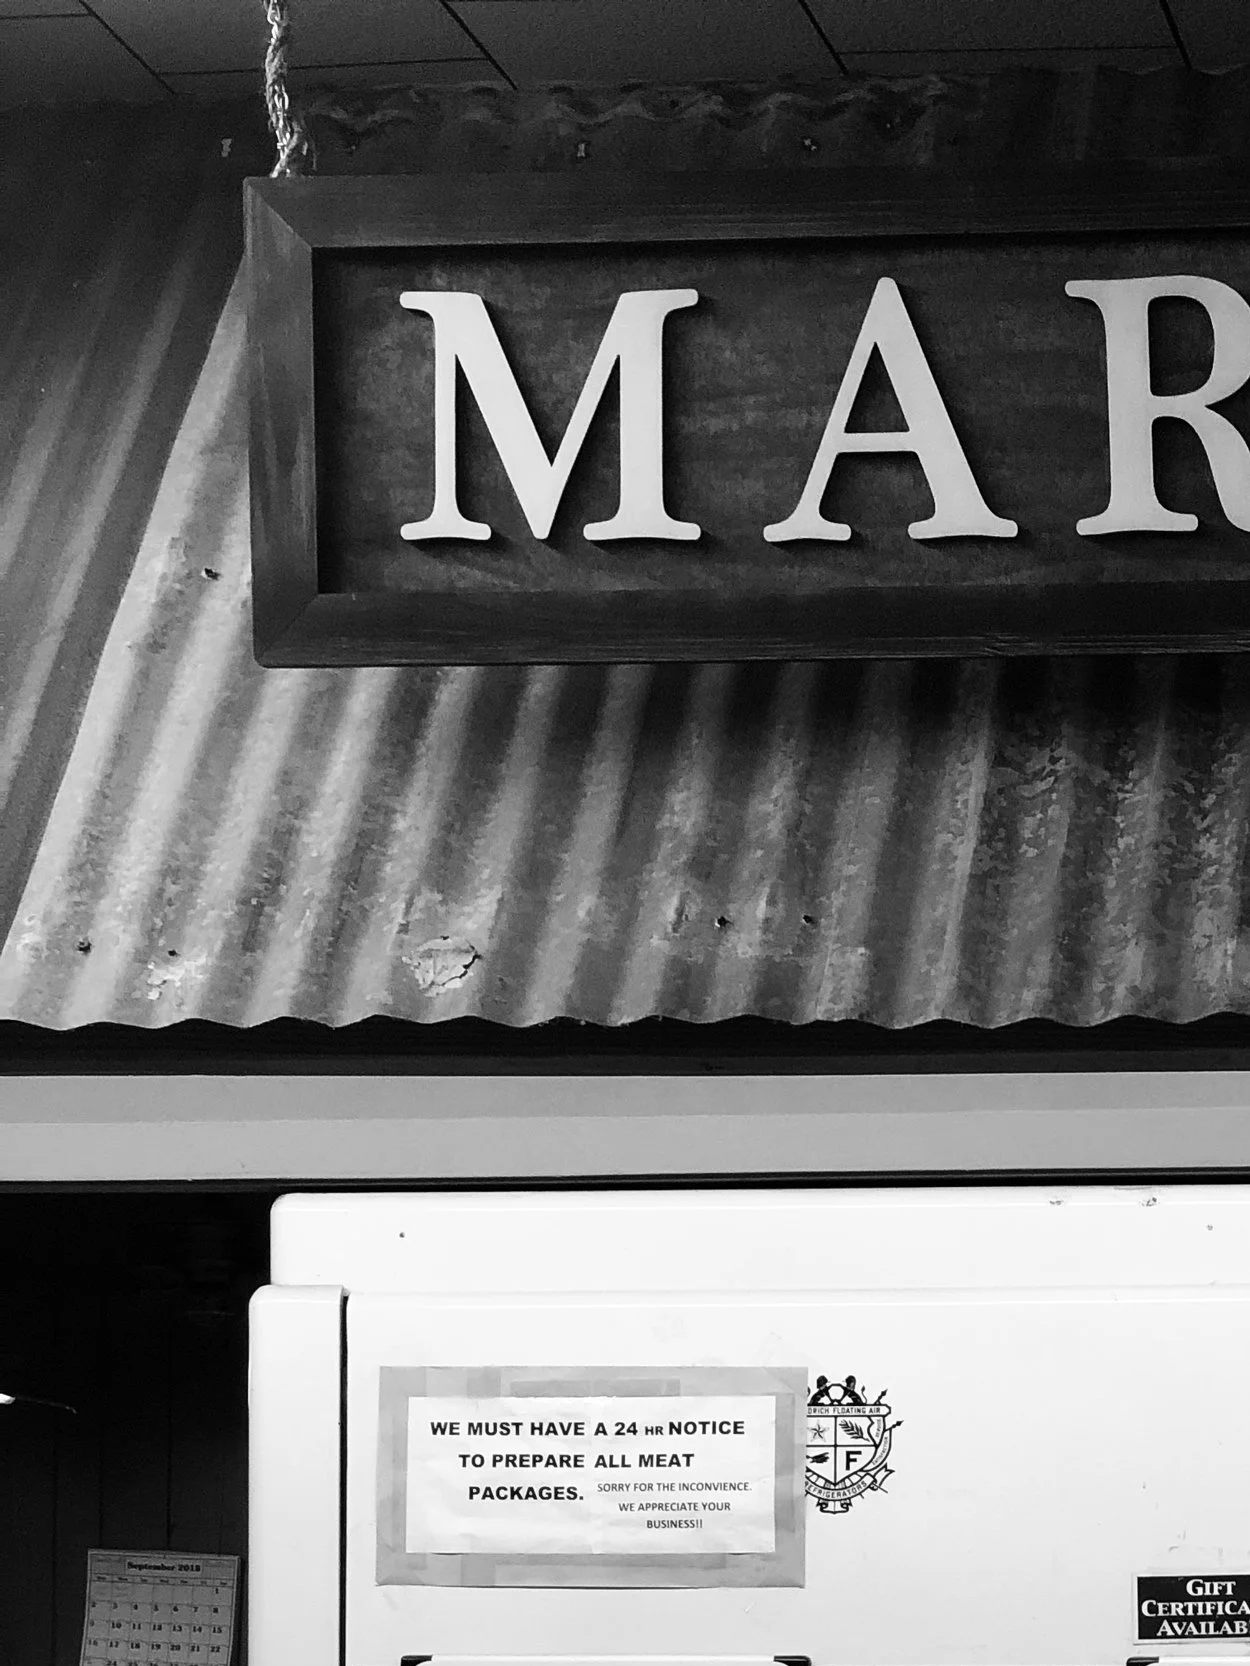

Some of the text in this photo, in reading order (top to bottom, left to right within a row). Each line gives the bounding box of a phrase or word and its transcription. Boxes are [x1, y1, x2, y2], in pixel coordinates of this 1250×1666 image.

[430, 1420, 746, 1437] WE MUST HAVE A 24 HR NOTICE
[458, 1453, 696, 1469] TO PREPARE ALL MEAT
[845, 1451, 862, 1471] F
[468, 1486, 585, 1502] PACKAGES.
[597, 1481, 753, 1493] SORRY FOR THE INCONVIENCE.
[618, 1502, 731, 1512] WE APPRECIATE YOUR
[127, 1561, 176, 1572] September
[212, 1626, 222, 1634] 15
